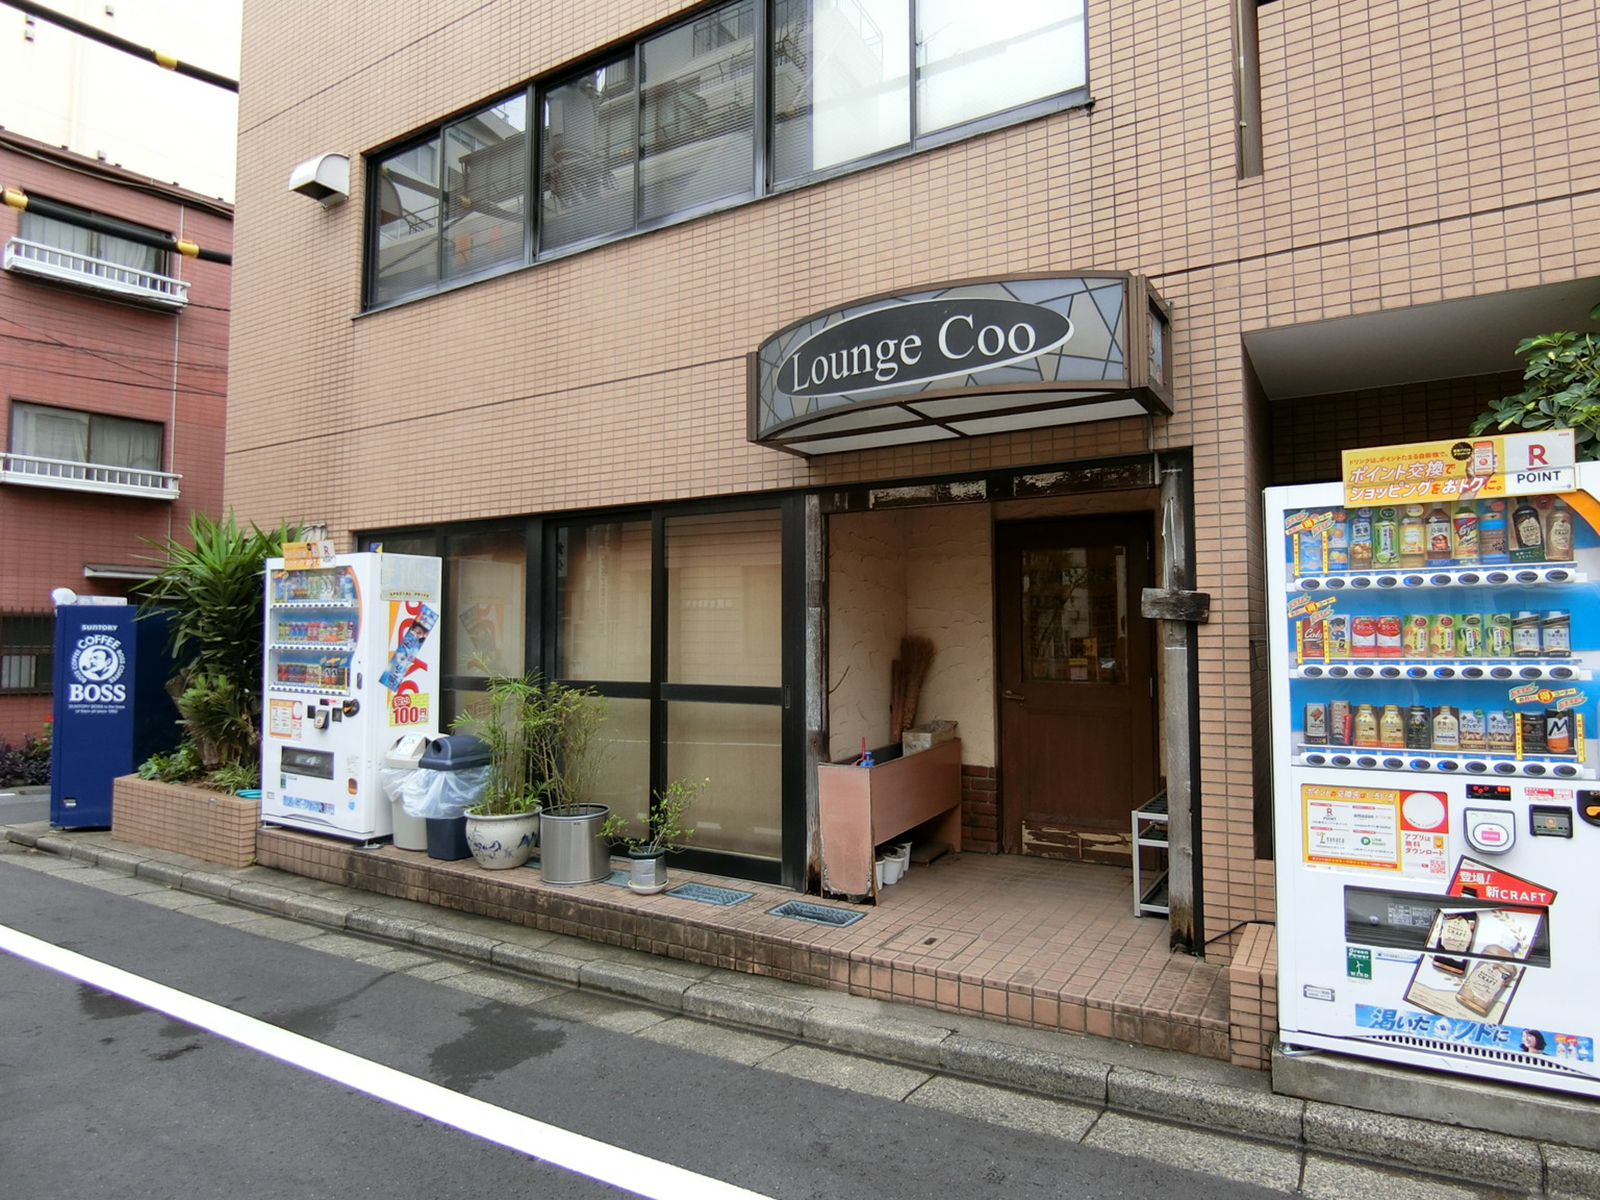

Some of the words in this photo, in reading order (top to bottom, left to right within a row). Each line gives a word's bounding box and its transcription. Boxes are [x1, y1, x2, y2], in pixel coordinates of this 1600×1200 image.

[792, 334, 922, 393] Lounge
[938, 314, 1036, 360] Coo
[1528, 444, 1549, 468] R
[1350, 460, 1456, 483] ポイント交換で
[1516, 470, 1562, 484] POINT
[1350, 477, 1502, 501] ショッピングをおトクに。
[77, 634, 122, 650] COFFEE
[69, 684, 126, 702] BOSS
[1405, 833, 1430, 842] アプリは
[1405, 848, 1444, 857] ダウンロード
[1459, 871, 1492, 885] 登場!
[1485, 886, 1547, 903] 新CRAFT
[1370, 1009, 1431, 1032] 渇いた
[1455, 1022, 1511, 1043] ノドに
